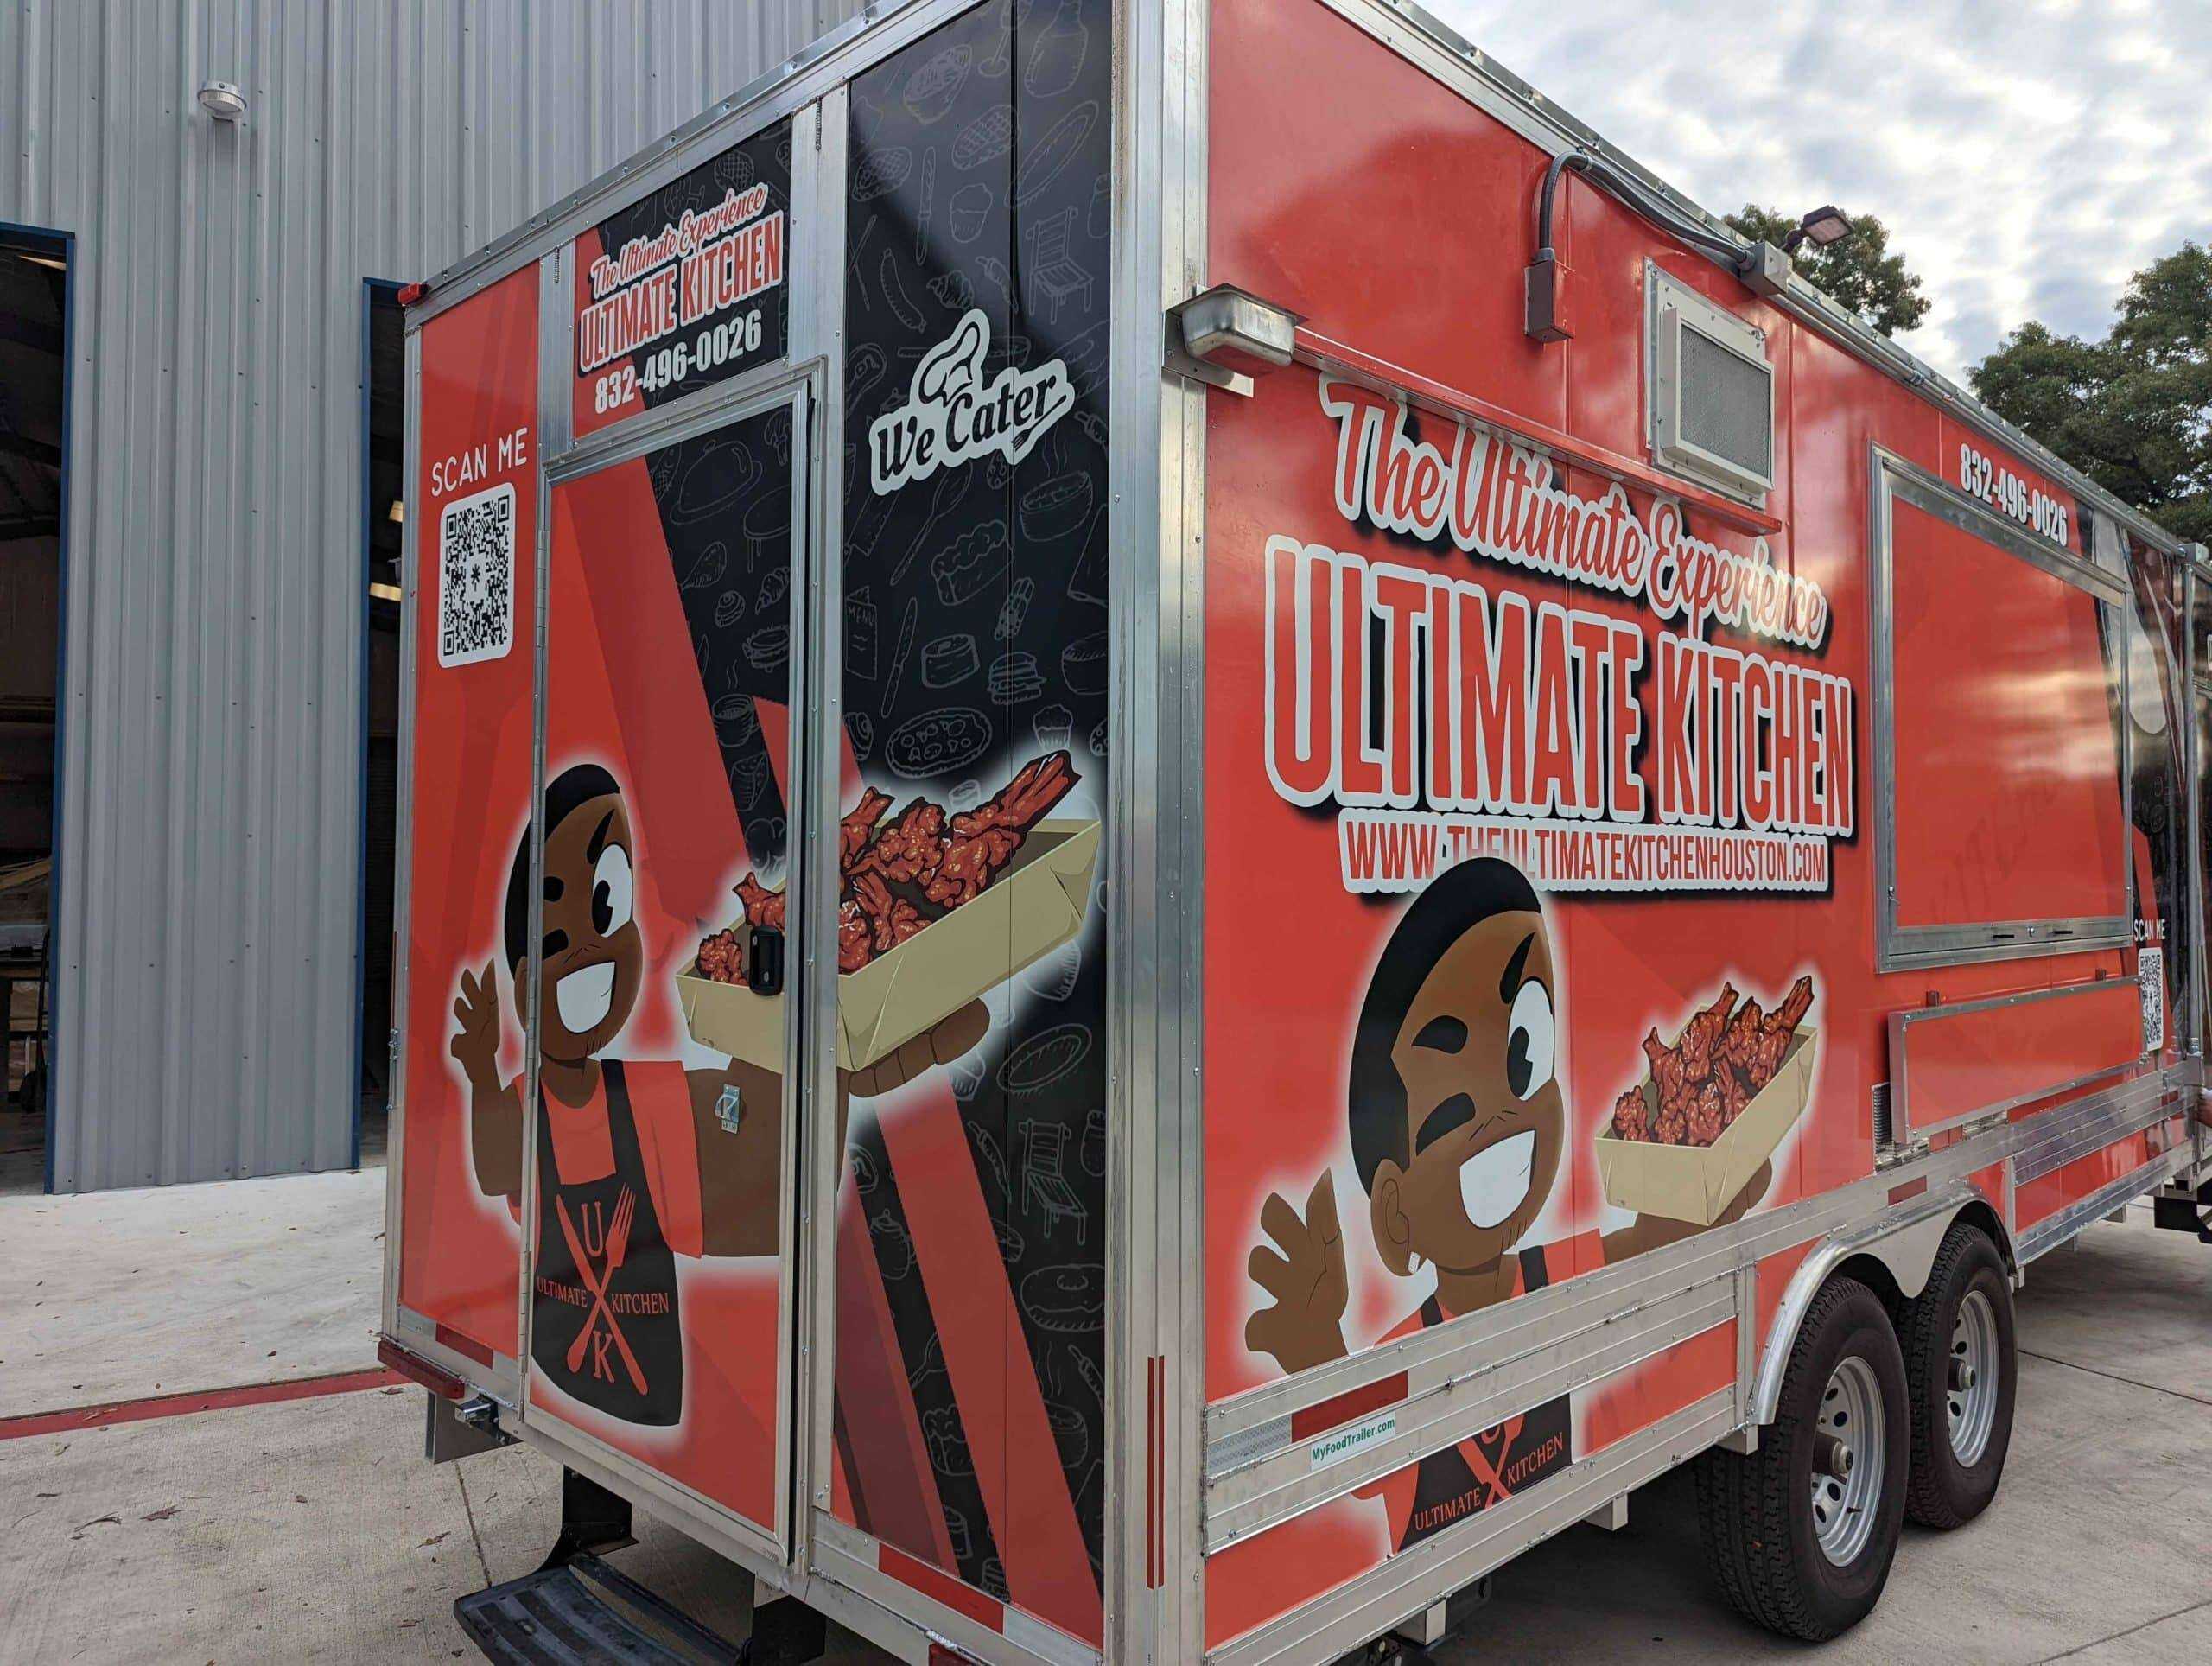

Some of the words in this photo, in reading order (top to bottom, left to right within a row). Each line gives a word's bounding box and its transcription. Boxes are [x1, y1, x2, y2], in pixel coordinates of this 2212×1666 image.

[581, 264, 677, 371] ULTIMATE
[682, 213, 782, 324] KITCHEN
[592, 258, 618, 297] The
[620, 235, 677, 283] Ultimate
[679, 187, 766, 254] Experience
[594, 308, 762, 414] 832-496-0026
[431, 442, 486, 497] SCAN
[498, 426, 528, 473] ME
[877, 415, 936, 482] We
[945, 373, 1041, 453] Cater
[1326, 379, 1449, 530] The
[1453, 426, 1646, 588] Ultimate
[1649, 501, 1827, 641] Experience
[1960, 442, 2068, 547] 832-496-0026
[1272, 548, 1642, 814] ULTIMATE
[1657, 633, 1853, 830] KITCHEN
[1344, 820, 1827, 883] WWWTHEULTIMATEKITCHENHOUSTON.COM
[2133, 919, 2154, 942] SCAN
[2156, 919, 2166, 941] ME
[581, 1200, 604, 1257] U
[536, 1275, 588, 1308] ULTIMATE
[611, 1291, 670, 1315] KITCHEN
[591, 1329, 617, 1383] K
[1311, 1416, 1395, 1462] MyFoodTrailer.com
[1414, 1485, 1482, 1532] ULTIMATE
[1505, 1430, 1565, 1488] KITCHEN
